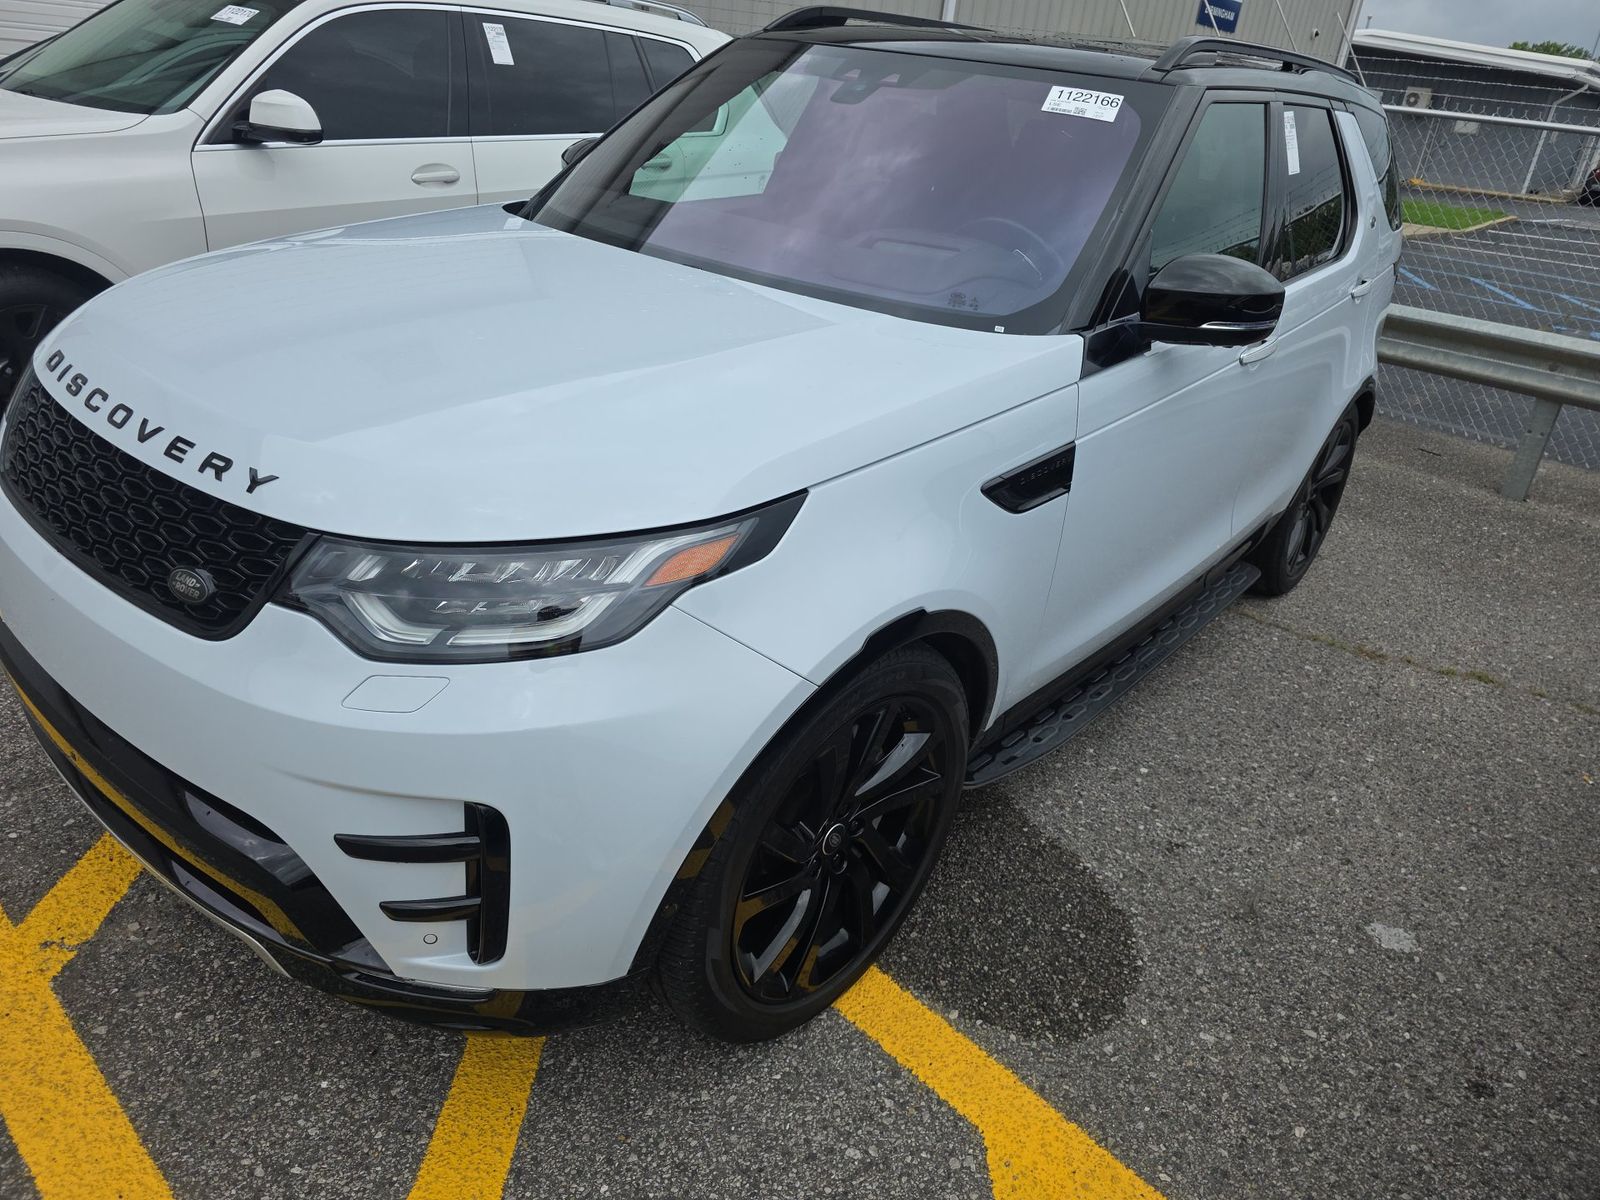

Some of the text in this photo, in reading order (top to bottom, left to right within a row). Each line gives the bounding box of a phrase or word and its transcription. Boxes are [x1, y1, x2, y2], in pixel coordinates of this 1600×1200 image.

[1057, 90, 1121, 109] 1122166
[45, 349, 280, 494] DISCOVERY
[175, 571, 197, 588] LAND
[175, 581, 200, 599] ROVER
